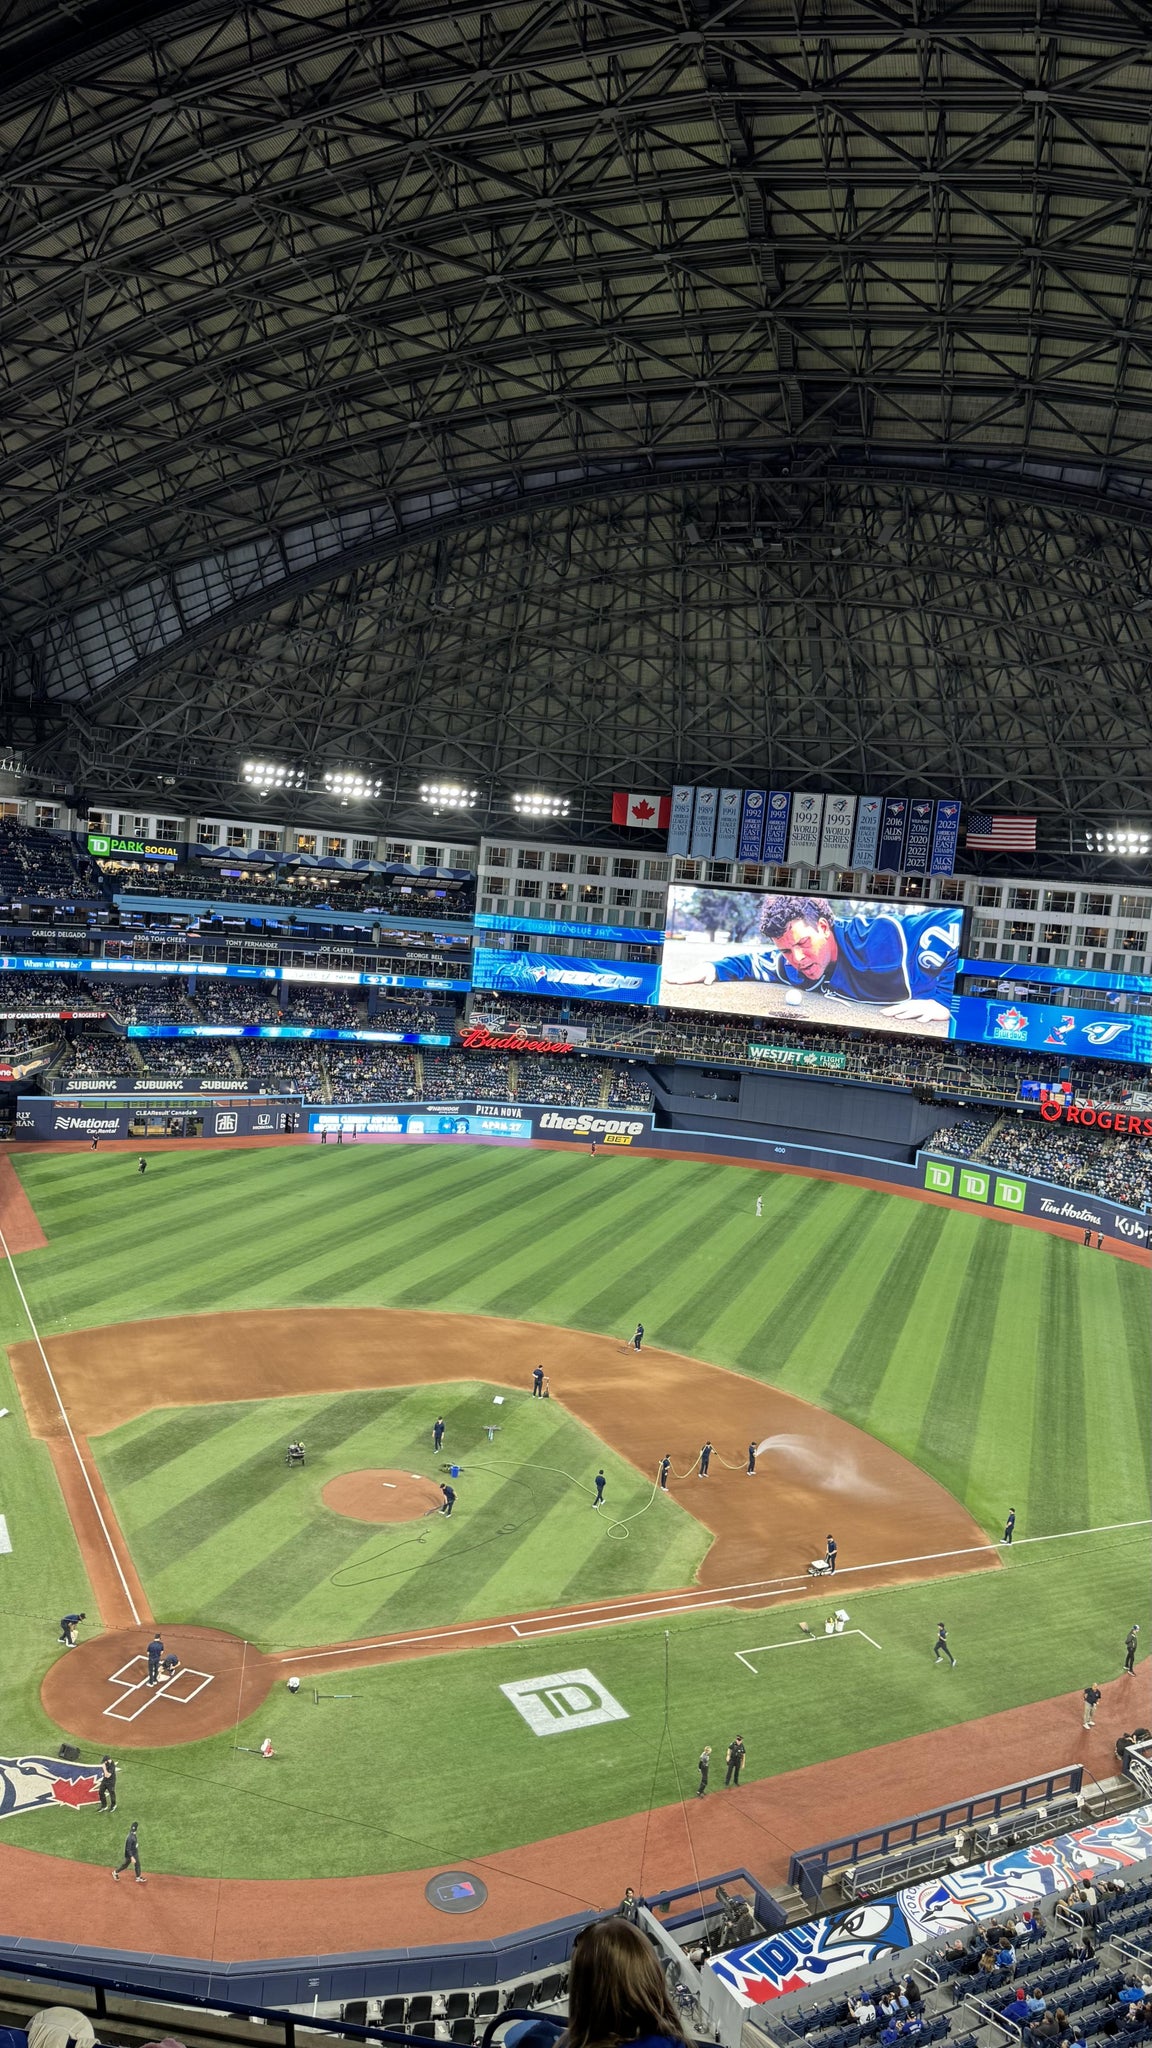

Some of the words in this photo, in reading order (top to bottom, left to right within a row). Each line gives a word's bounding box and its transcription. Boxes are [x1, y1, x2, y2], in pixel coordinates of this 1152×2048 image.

[796, 812, 817, 824] 1992
[828, 814, 850, 826] 1993
[886, 817, 902, 826] 2016
[794, 825, 817, 833] WORLD
[826, 827, 850, 835] WORLD
[909, 835, 928, 844] 2020
[90, 839, 108, 852] TD
[111, 840, 144, 851] PARK
[145, 846, 178, 856] SOCIAL
[908, 847, 926, 855] 2022
[907, 858, 925, 866] 2023
[572, 926, 592, 935] BLUE
[547, 969, 643, 989] WEEKEND
[460, 1028, 574, 1052] Budweiser
[750, 1047, 804, 1062] WESTJET
[66, 1081, 116, 1090] SUBWAY
[134, 1081, 183, 1090] SUBWAY
[200, 1081, 248, 1090] SUBWAY
[476, 1105, 498, 1115] PIZZA
[501, 1107, 522, 1118] NOVA
[539, 1112, 644, 1135] theScore
[1067, 1106, 1152, 1136] ROGERS
[930, 1167, 950, 1187] TD
[963, 1175, 985, 1195] TD
[999, 1184, 1022, 1204] TD
[1040, 1198, 1060, 1215] Tim
[1061, 1204, 1101, 1225] Hortons
[517, 1682, 602, 1719] TD
